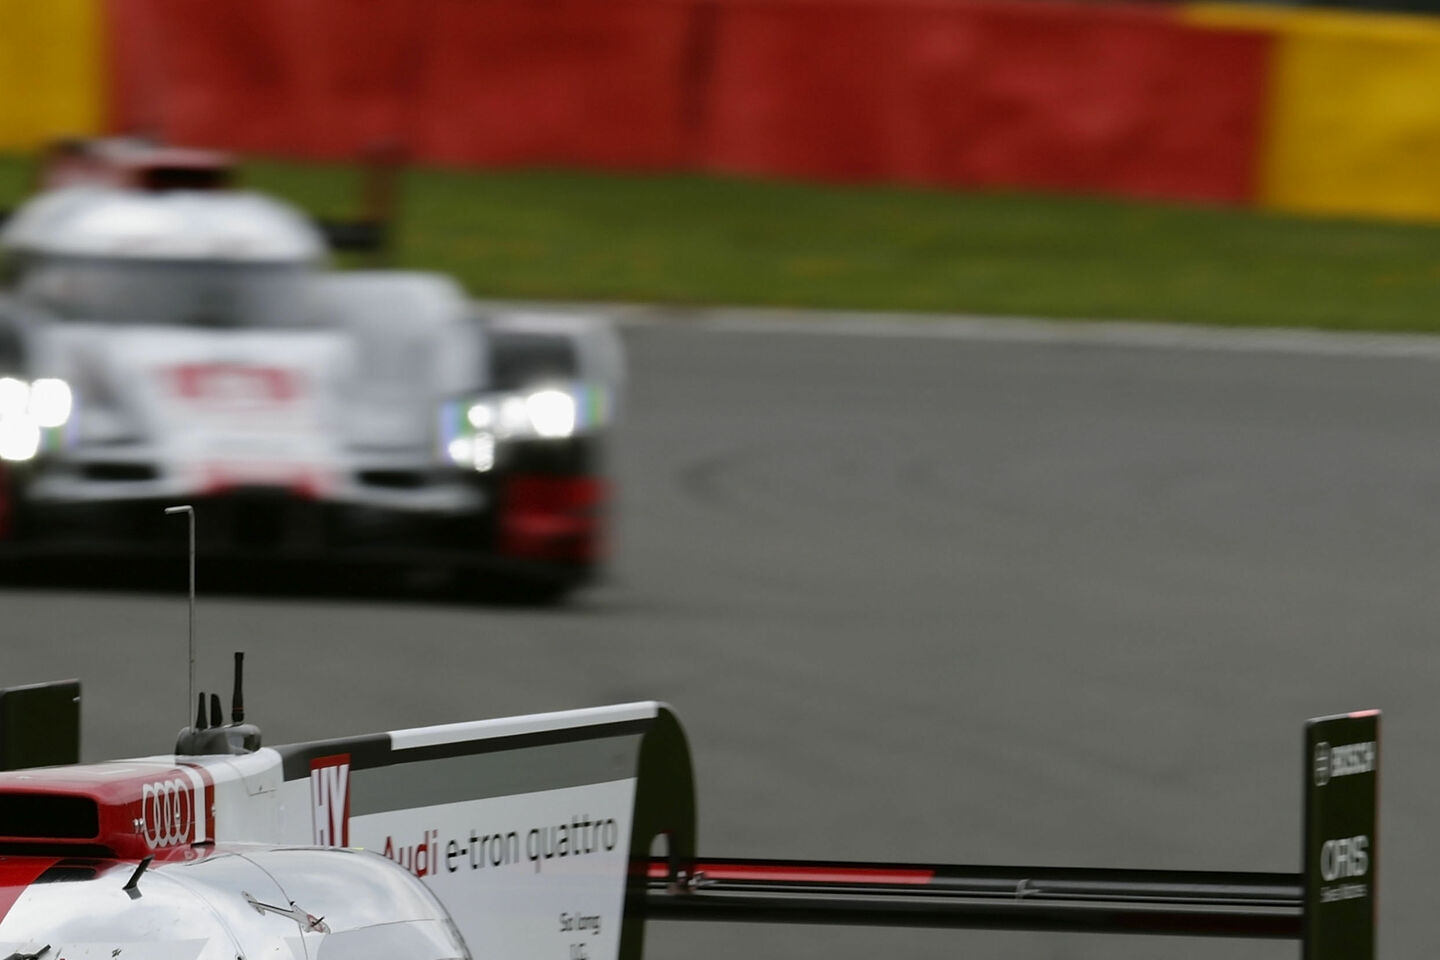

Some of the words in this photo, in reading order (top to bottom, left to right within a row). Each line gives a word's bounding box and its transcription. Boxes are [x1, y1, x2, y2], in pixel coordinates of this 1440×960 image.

[310, 764, 350, 848] HY
[445, 829, 520, 873] e-tron
[526, 813, 618, 873] quattro
